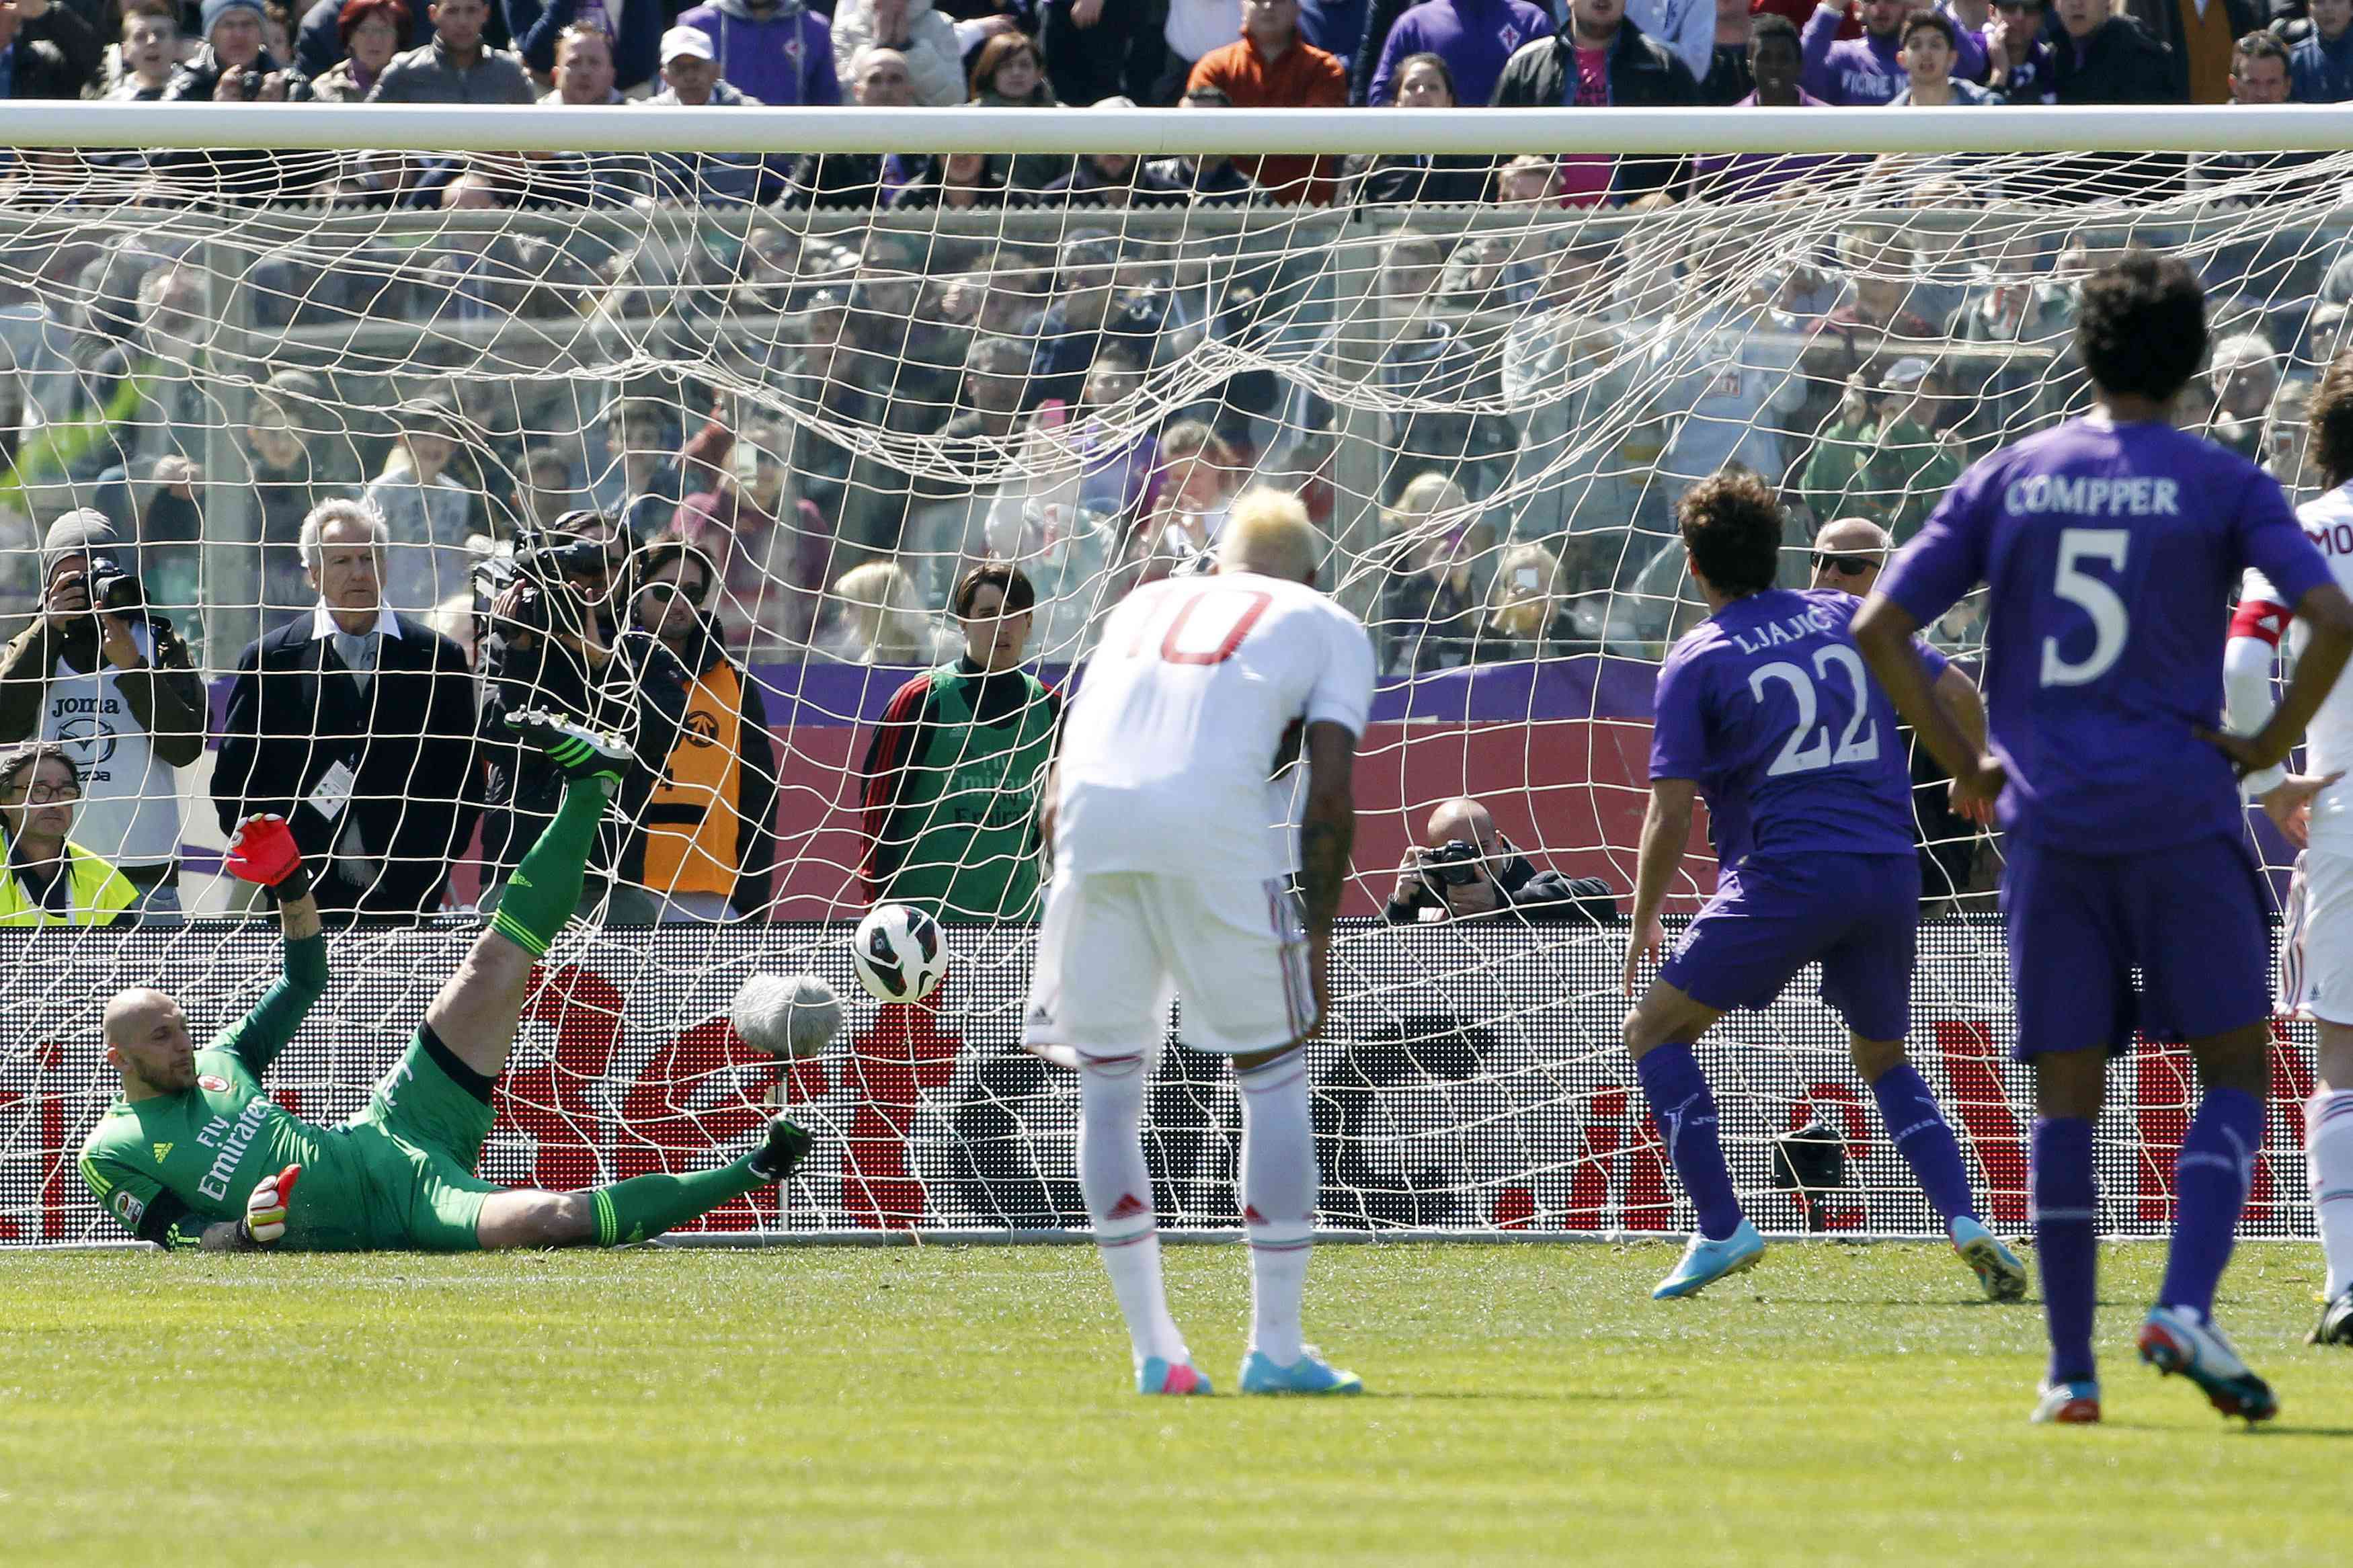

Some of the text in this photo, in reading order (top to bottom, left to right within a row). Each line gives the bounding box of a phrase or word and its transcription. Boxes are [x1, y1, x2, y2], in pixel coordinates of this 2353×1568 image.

[2004, 474, 2179, 516] COMPPER
[2040, 528, 2129, 688] 5
[1748, 643, 1880, 776] 22
[196, 1115, 231, 1149] Fly
